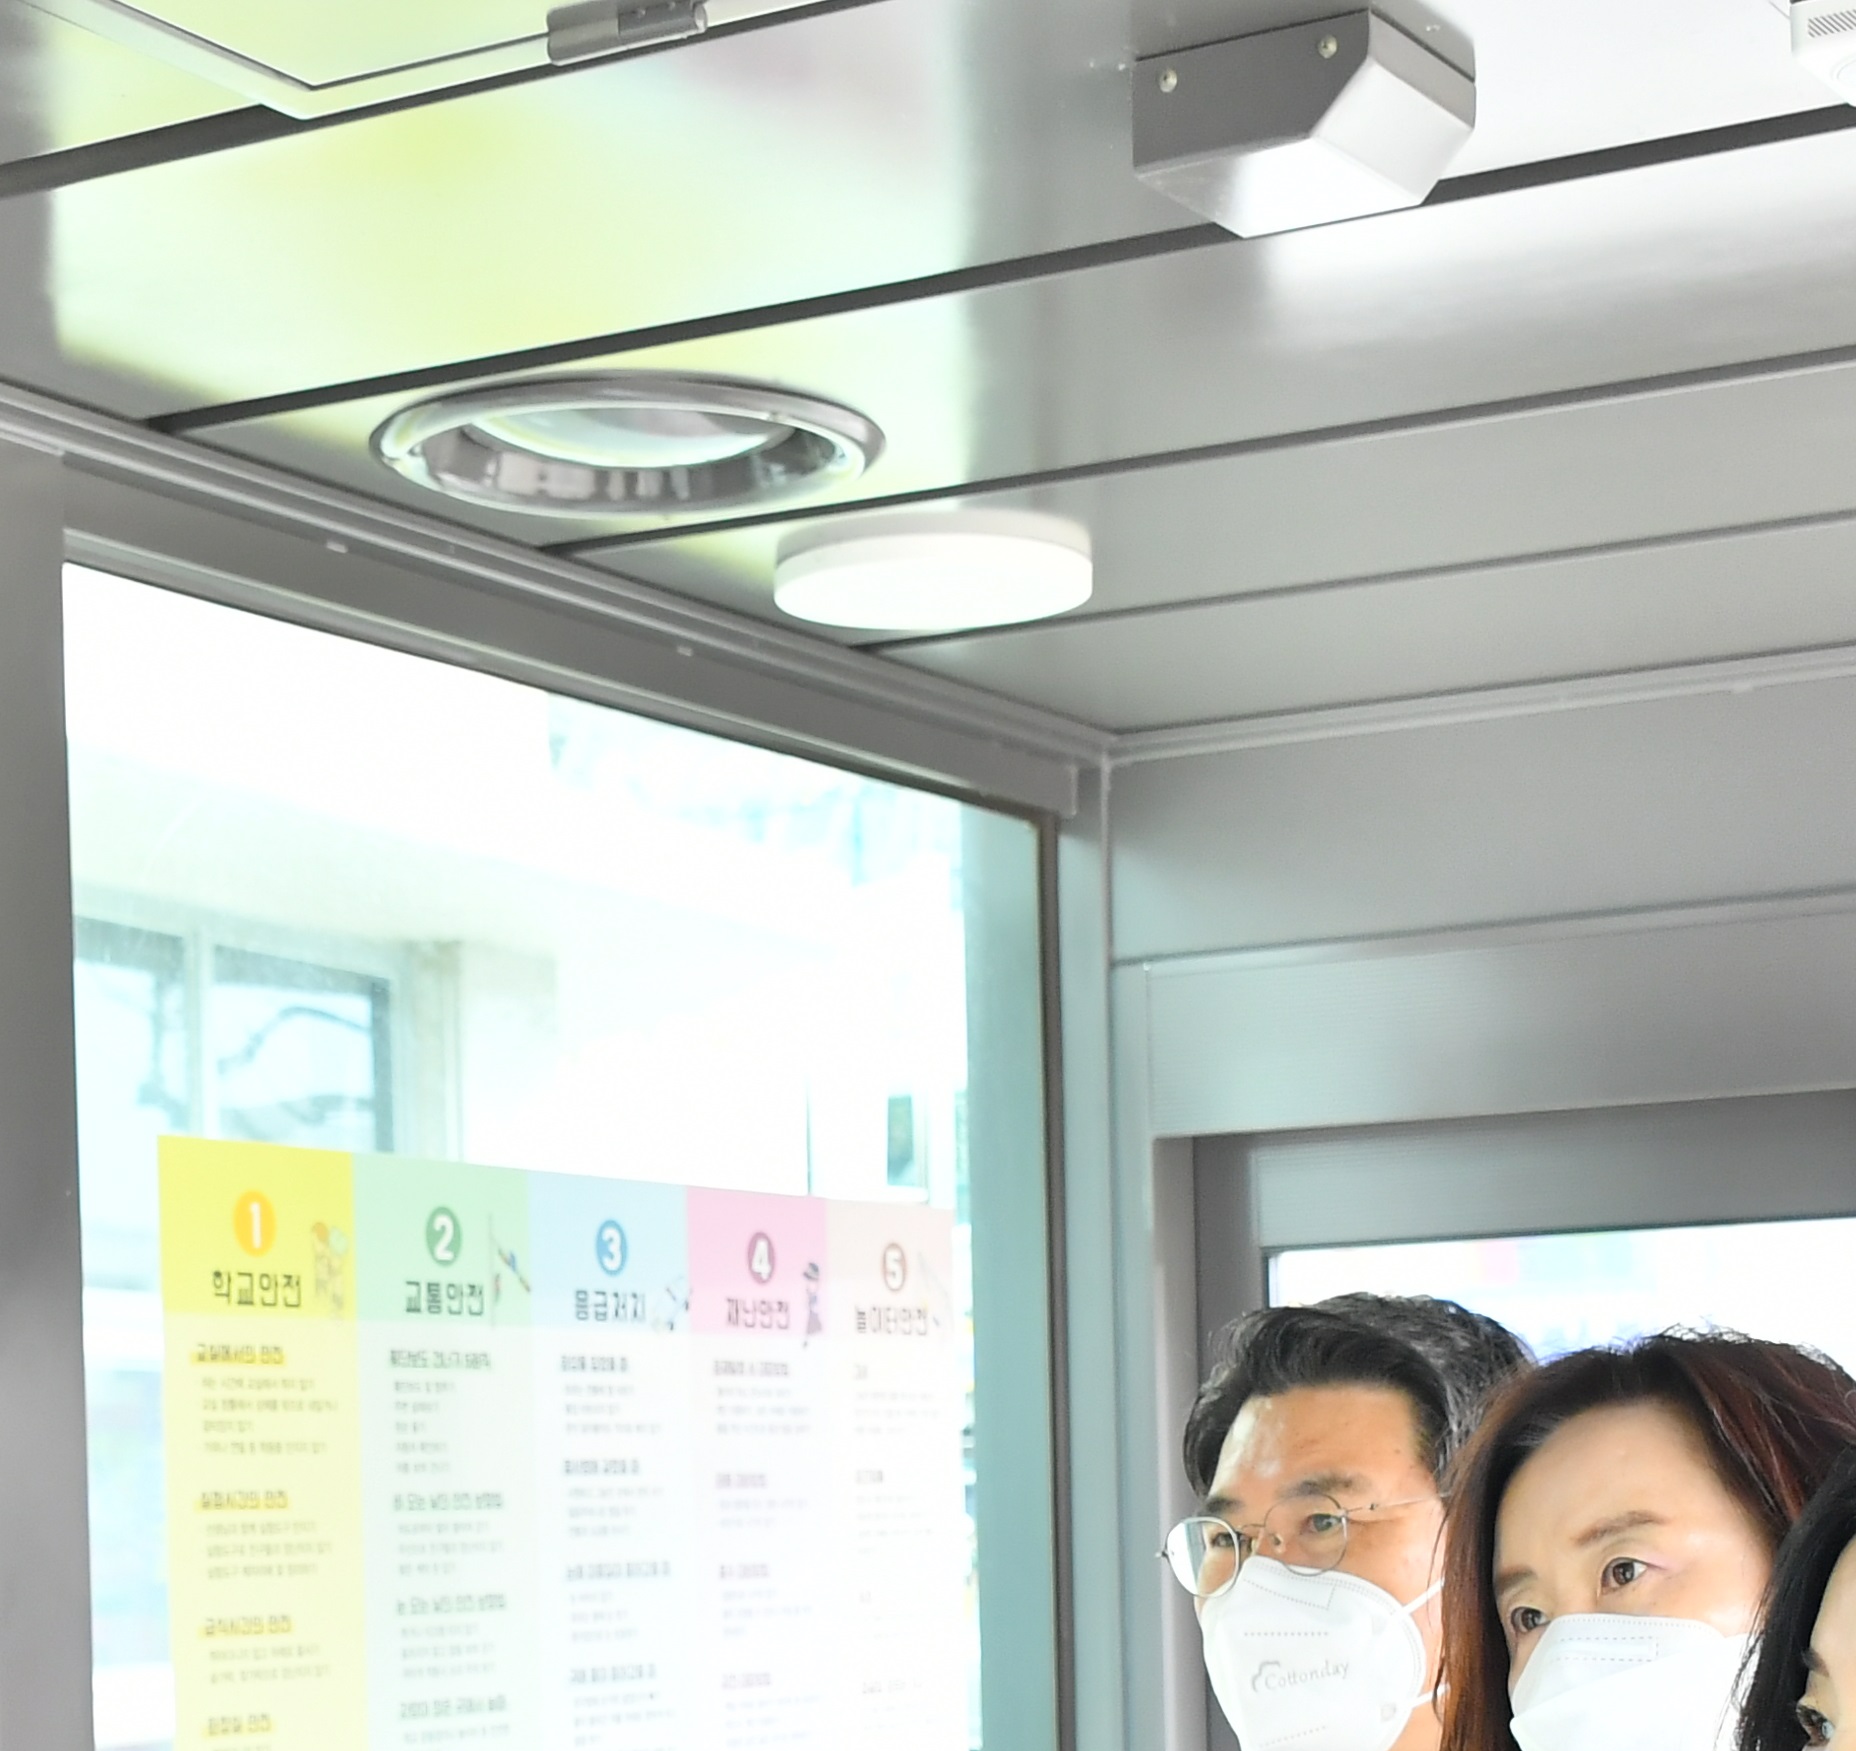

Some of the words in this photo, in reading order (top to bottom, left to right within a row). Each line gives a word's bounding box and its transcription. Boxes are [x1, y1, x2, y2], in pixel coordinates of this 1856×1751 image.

[249, 1201, 263, 1249] 1
[432, 1215, 456, 1262] 2
[601, 1228, 623, 1269] 3
[752, 1237, 772, 1280] 4
[885, 1248, 906, 1288] 5
[211, 1269, 302, 1309] 학교안전
[404, 1279, 485, 1317] 교통안전
[1265, 1659, 1349, 1690] Cottonday
